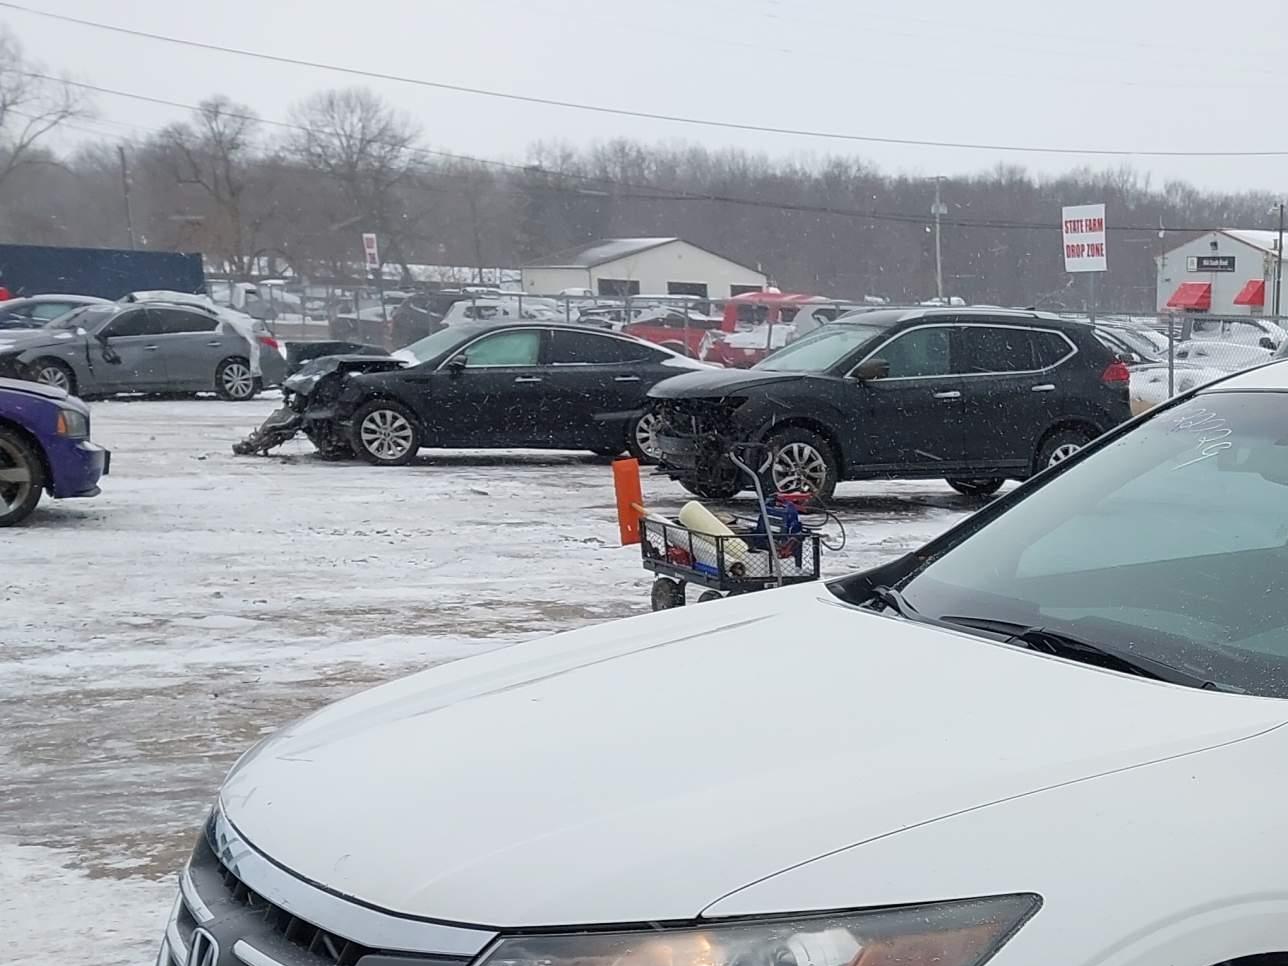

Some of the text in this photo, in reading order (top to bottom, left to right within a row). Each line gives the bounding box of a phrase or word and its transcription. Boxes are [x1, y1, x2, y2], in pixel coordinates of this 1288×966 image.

[1064, 217, 1104, 234] STATE FARM
[1066, 243, 1104, 258] DROP ZONE
